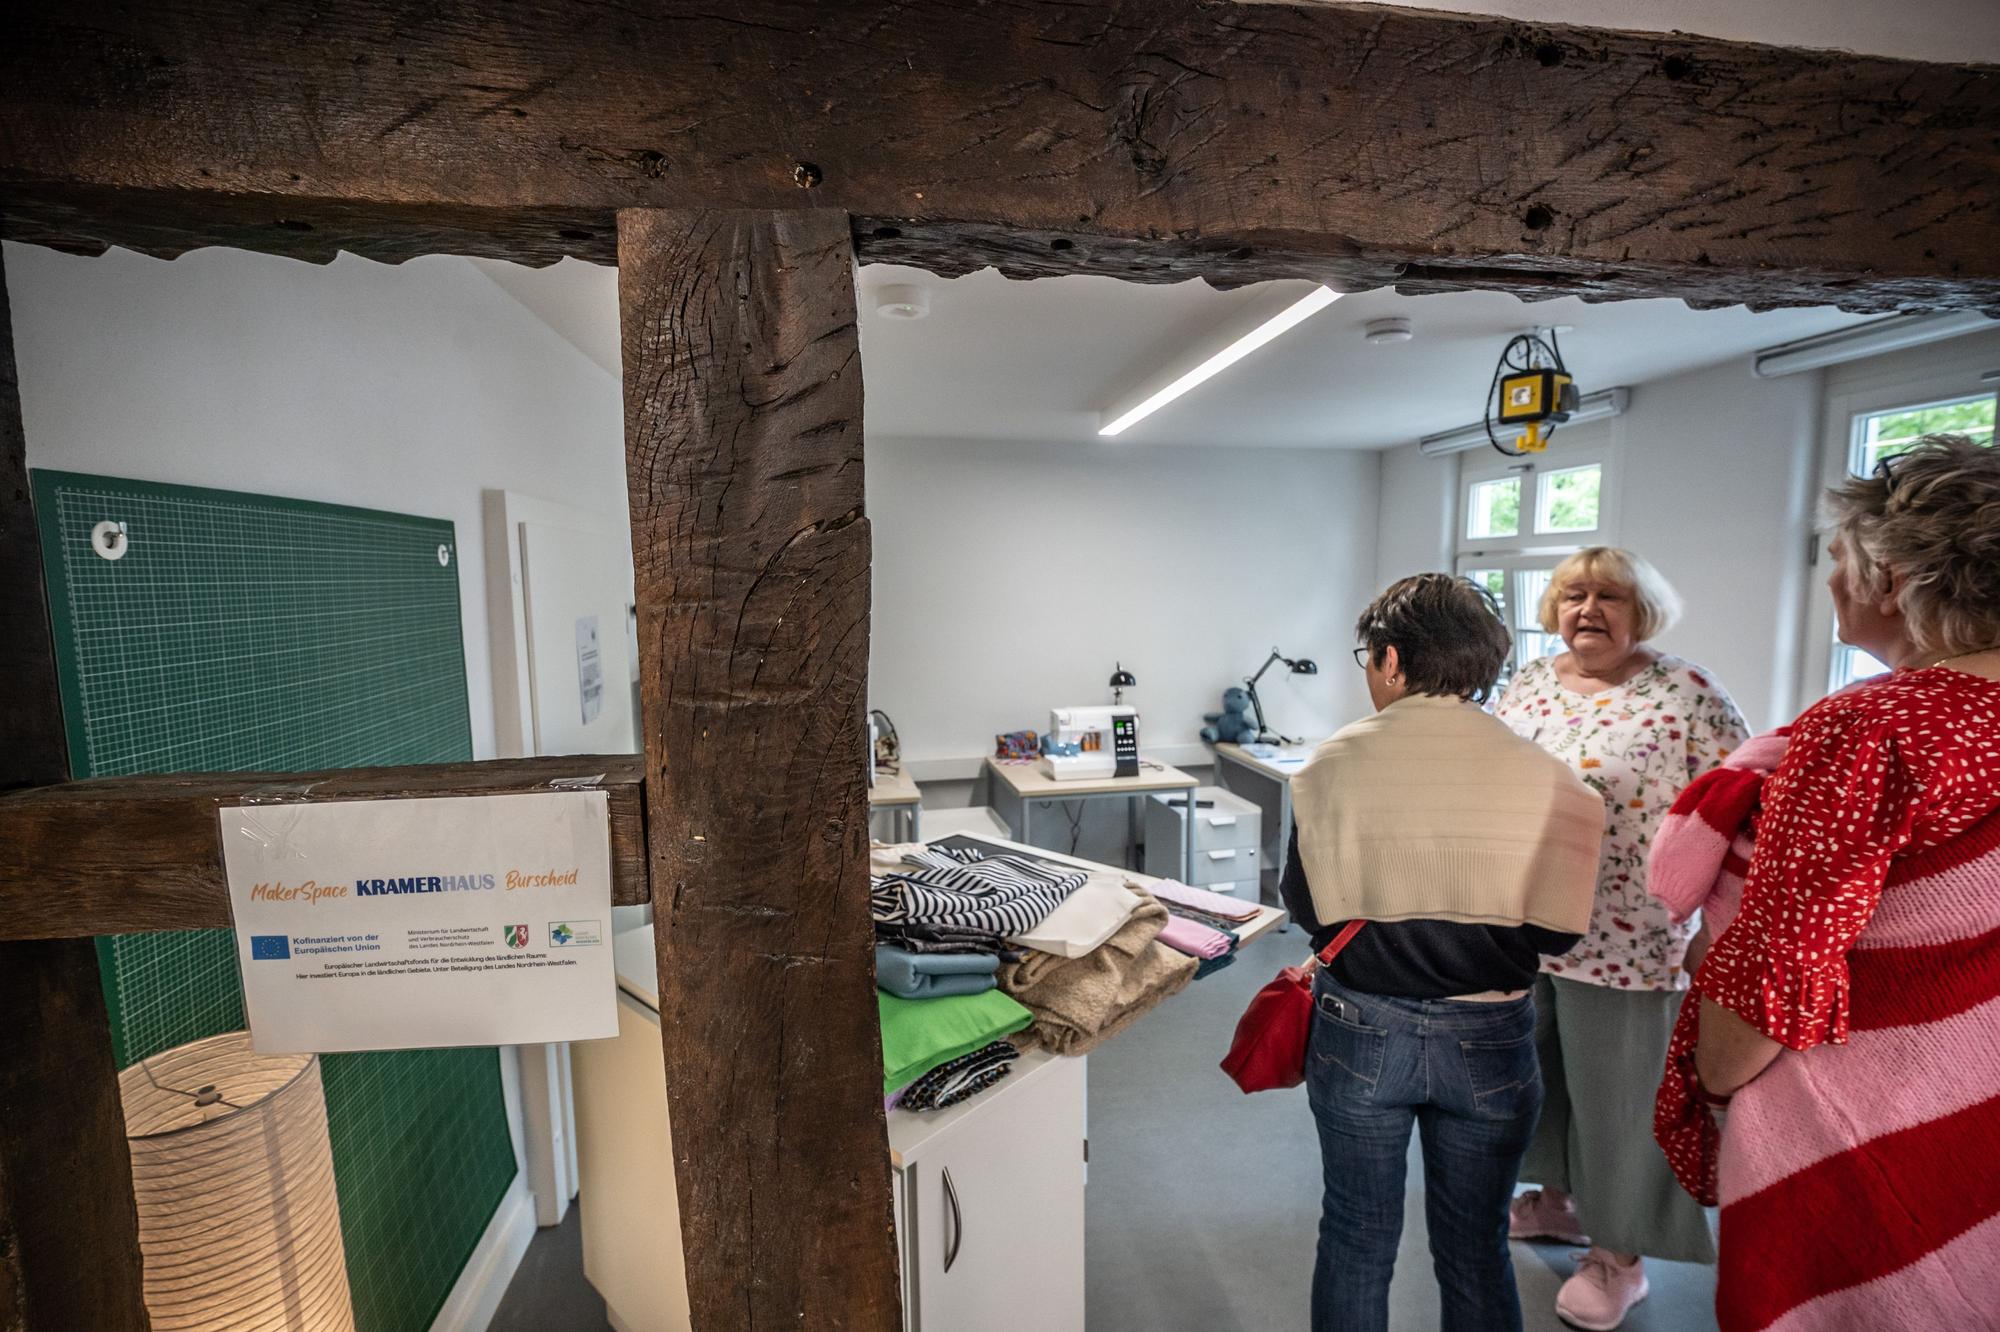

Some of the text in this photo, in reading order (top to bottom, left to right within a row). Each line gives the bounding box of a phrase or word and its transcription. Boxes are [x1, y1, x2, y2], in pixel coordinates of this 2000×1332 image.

[250, 868, 580, 906] MakerSpace KRAMERHAUS Burscheid
[293, 935, 345, 945] Kofinanziert
[294, 943, 381, 955] Europäischen Union
[338, 970, 360, 978] Europa
[495, 962, 515, 970] Landes
